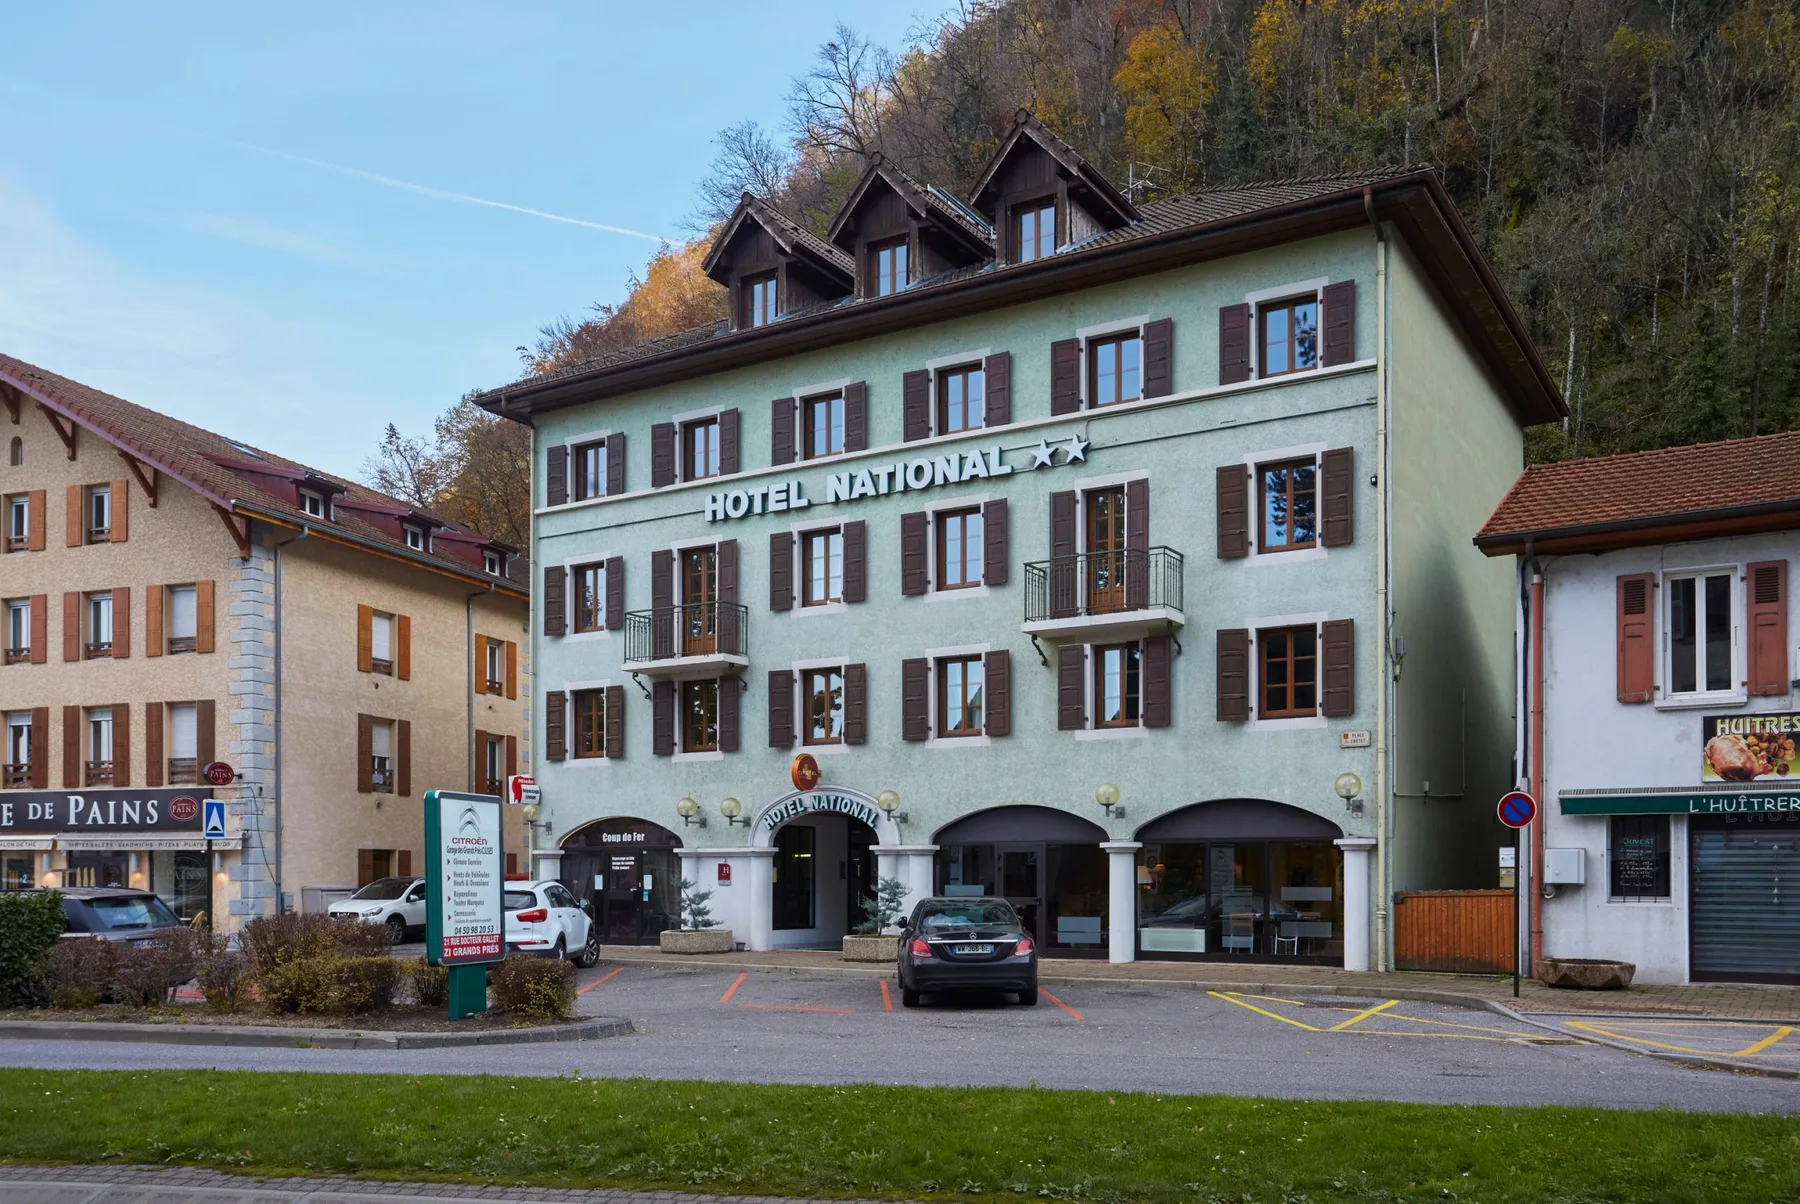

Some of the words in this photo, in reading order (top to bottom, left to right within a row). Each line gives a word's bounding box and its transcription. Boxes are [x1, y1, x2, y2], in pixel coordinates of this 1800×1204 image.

[705, 481, 809, 522] HOTEL
[827, 446, 1012, 502] NATIONAL
[210, 770, 232, 778] PAINS
[172, 804, 196, 813] PAINS
[762, 798, 806, 830] HOTEL
[810, 795, 879, 828] NATIONAL
[1, 803, 14, 827] E
[28, 803, 54, 820] DE
[452, 836, 488, 845] CITROËN
[602, 833, 621, 843] Coup
[622, 833, 632, 841] de
[633, 832, 645, 841] Fer
[455, 927, 462, 935] 04
[462, 926, 470, 935] 50
[471, 926, 478, 934] 98
[479, 925, 486, 933] 20
[487, 925, 494, 933] 53
[444, 938, 450, 946] 21
[451, 937, 460, 945] RUE
[461, 936, 482, 945] DOCTEUR
[483, 935, 499, 943] GALLET
[453, 946, 481, 956] GRANDS
